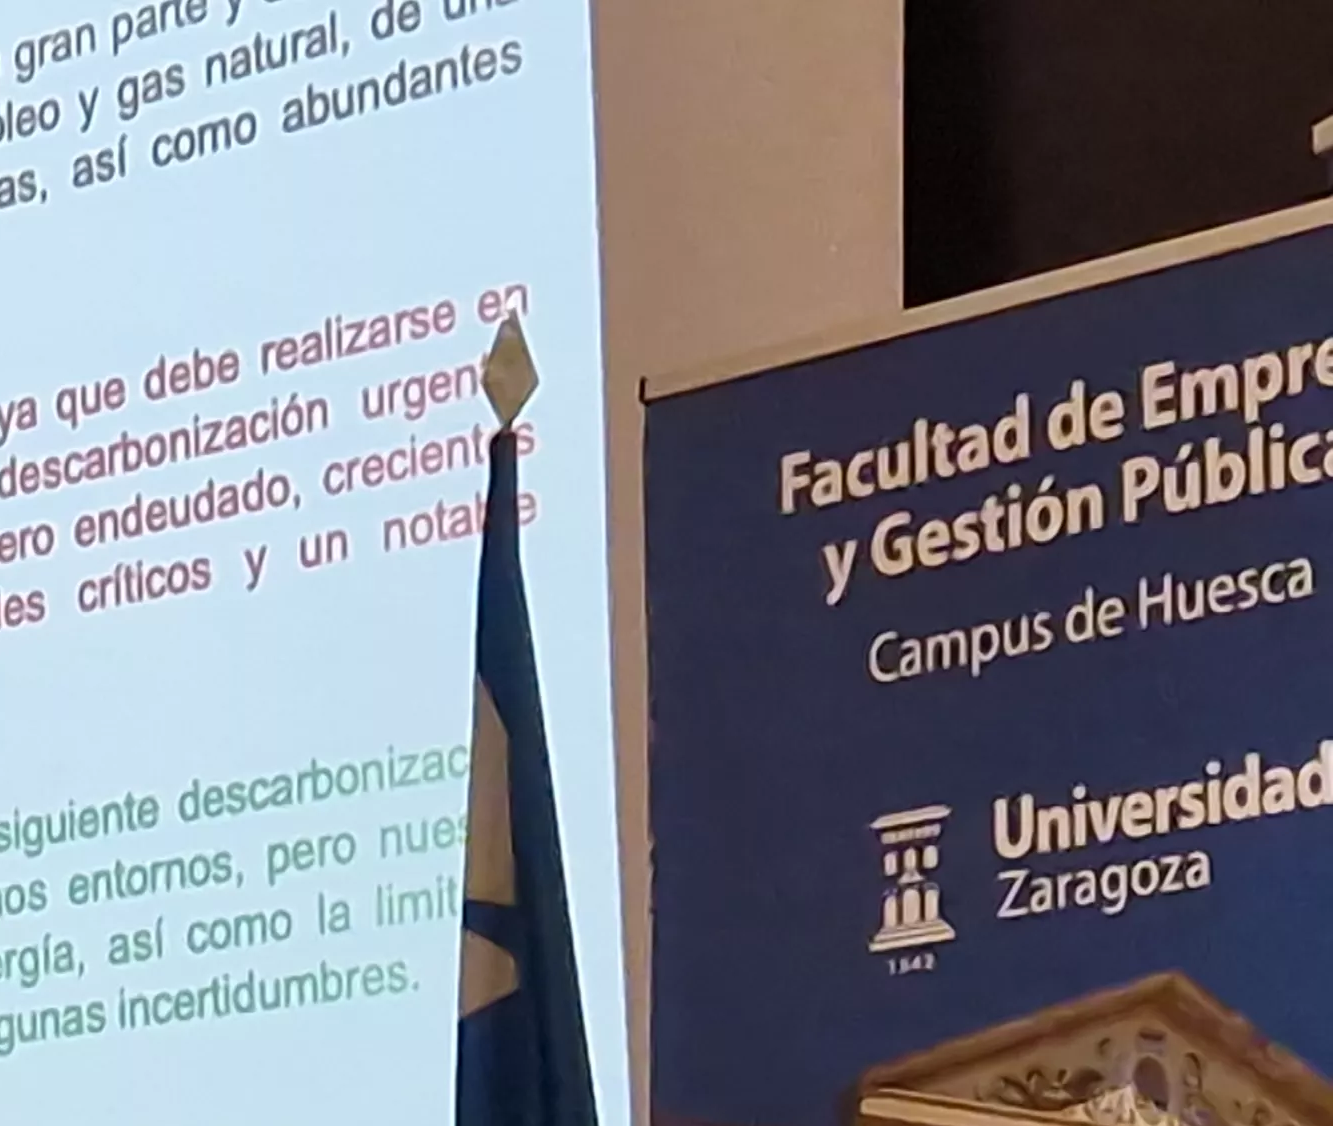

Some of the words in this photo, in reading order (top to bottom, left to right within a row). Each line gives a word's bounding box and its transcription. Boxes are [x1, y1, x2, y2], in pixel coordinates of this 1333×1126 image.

[14, 22, 96, 84] gran
[112, 0, 208, 57] parte
[78, 86, 99, 133] y
[117, 63, 185, 121] gas
[206, 10, 350, 88] natural,
[371, 0, 421, 40] de
[72, 133, 128, 188] así
[152, 111, 257, 167] como
[282, 38, 522, 133] abundantes
[56, 378, 126, 430] que
[143, 347, 240, 401] debe
[261, 300, 456, 376] realizarse
[477, 284, 529, 324] en
[362, 355, 489, 421] urgen
[74, 467, 301, 548] endeudado,
[322, 421, 535, 496] crecients
[780, 392, 1030, 514] Facultad
[1047, 380, 1125, 450] de
[1142, 336, 1333, 431] Empre
[78, 558, 212, 612] críticos
[244, 545, 267, 592] y
[300, 530, 348, 568] un
[384, 490, 537, 552] notae
[821, 538, 858, 606] y
[872, 475, 1103, 577] Gestión
[868, 610, 1053, 683] Campus
[1066, 588, 1124, 643] de
[1139, 557, 1315, 630] Huesca
[178, 745, 468, 822] descarbonizac
[993, 739, 1333, 860] Universidad
[69, 851, 243, 905] entornos,
[267, 833, 356, 887] pero
[108, 914, 163, 965] así
[187, 909, 292, 954] como
[318, 892, 350, 935] la
[376, 873, 458, 926] limit
[997, 849, 1211, 919] Zaragoza
[119, 957, 419, 1029] incertidumbres.
